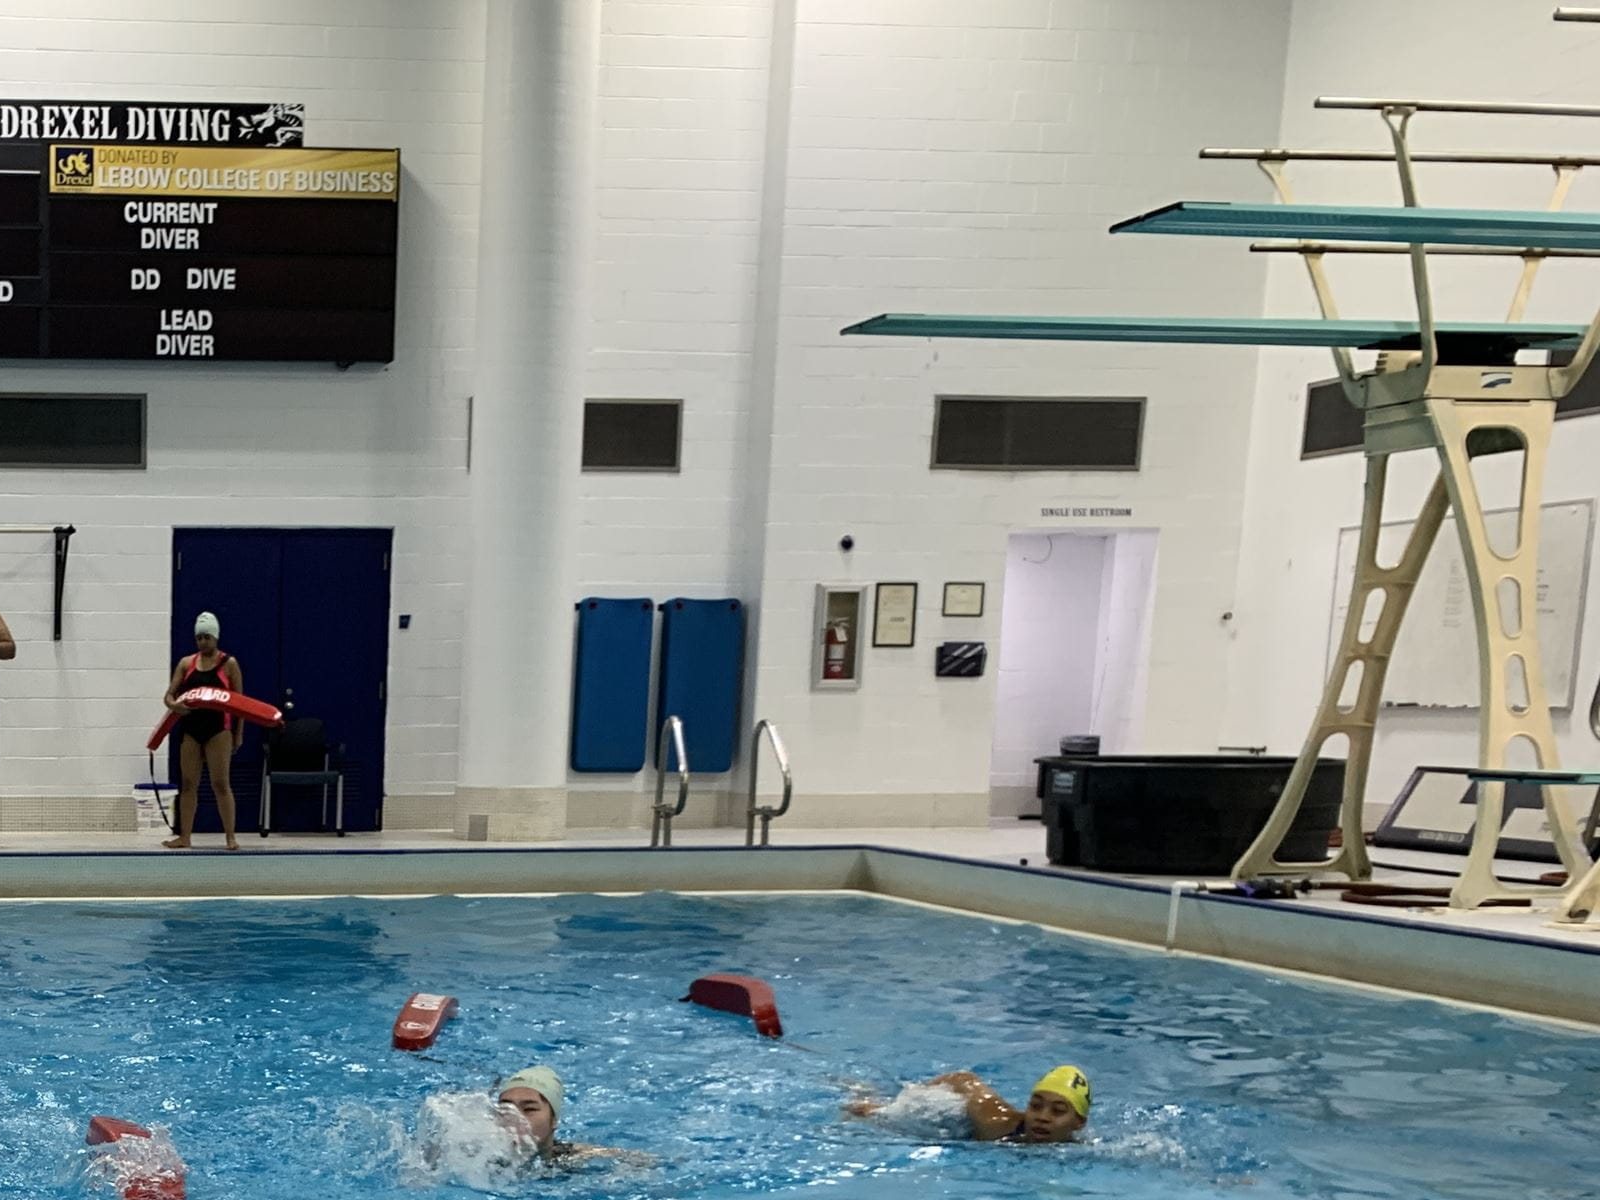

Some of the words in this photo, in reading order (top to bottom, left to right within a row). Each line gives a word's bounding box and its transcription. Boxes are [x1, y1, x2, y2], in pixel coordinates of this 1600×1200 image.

[0, 105, 118, 140] DREXEL
[127, 107, 231, 142] DIVING
[98, 148, 160, 165] DONATED
[162, 150, 178, 165] BY
[98, 167, 174, 188] LEBOW
[175, 168, 259, 190] COLLEGE
[264, 170, 290, 191] OF
[295, 171, 396, 193] BUSINESS
[124, 201, 218, 224] CURRENT
[140, 228, 200, 250] DIVER
[131, 268, 161, 290] DD
[186, 268, 236, 290] DIVE
[160, 309, 213, 331] LEAD
[156, 334, 215, 356] DIVER
[1040, 507, 1069, 517] SINGLE
[1073, 507, 1087, 517] USE
[1090, 507, 1132, 517] RESTROOM
